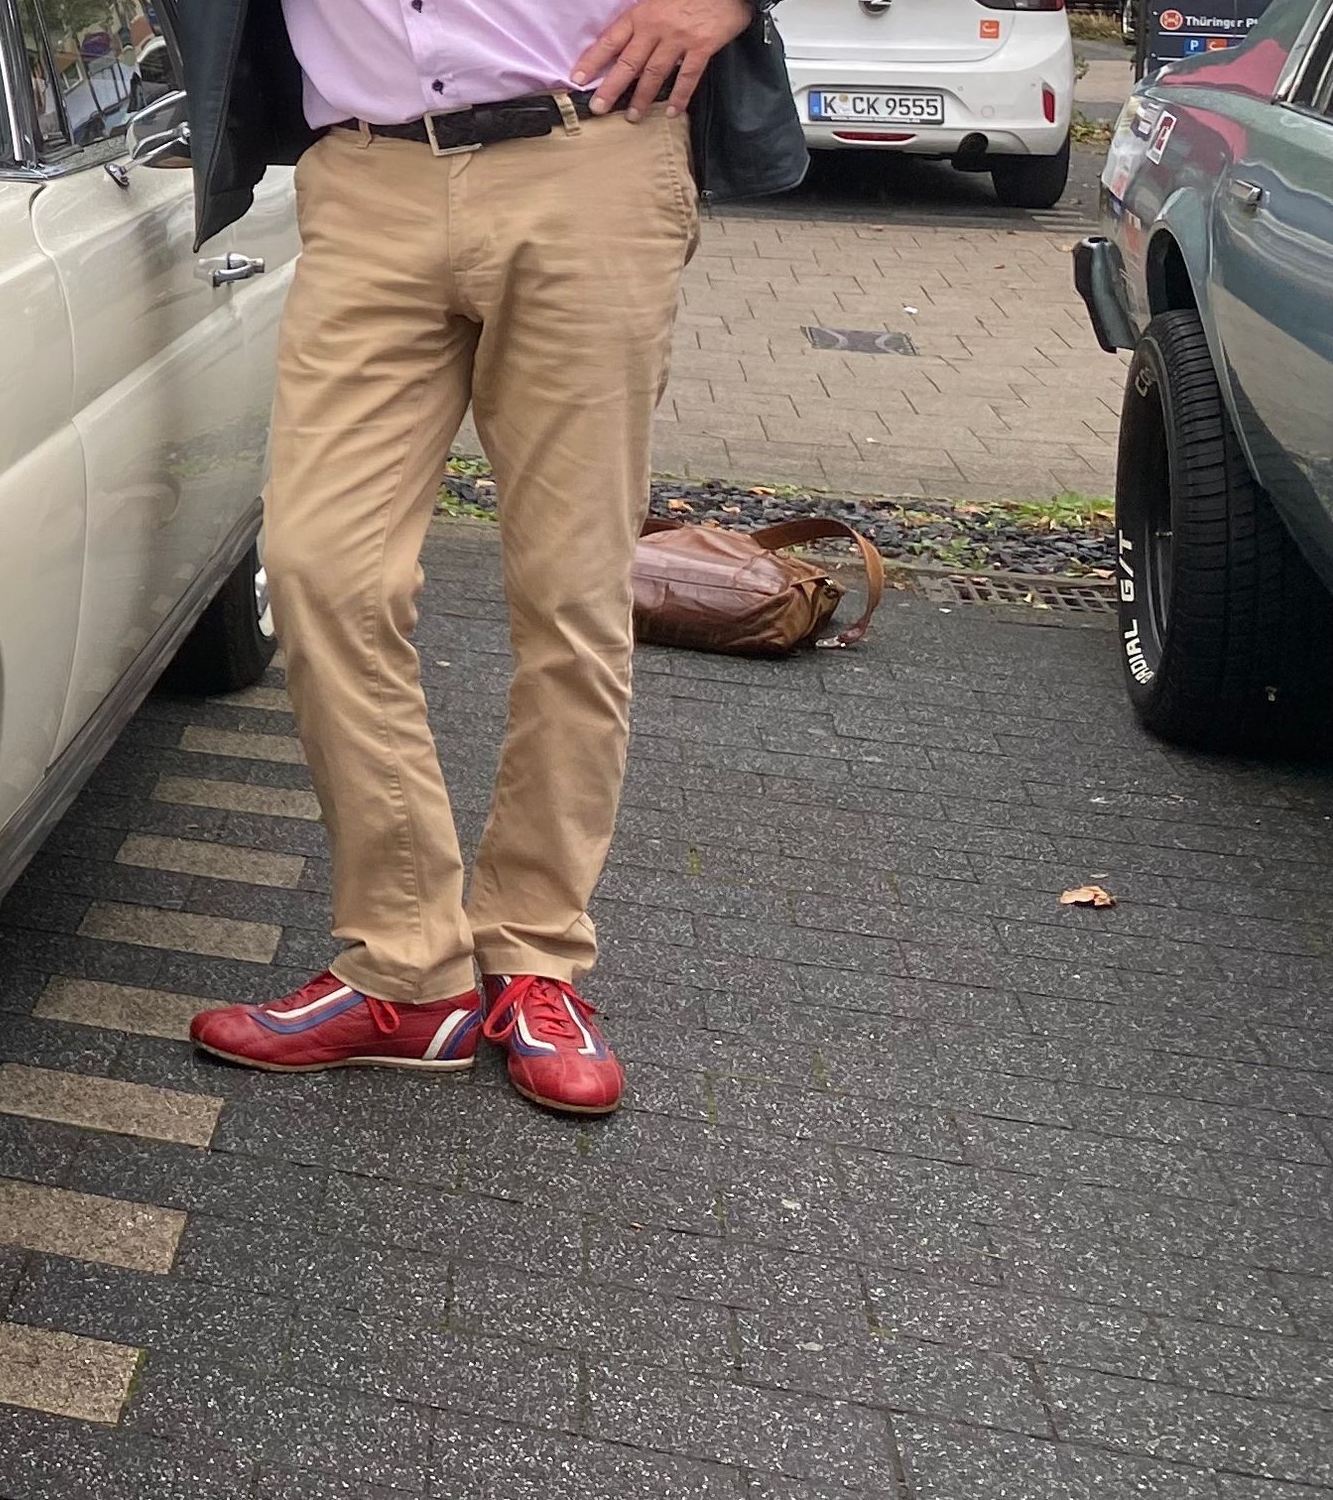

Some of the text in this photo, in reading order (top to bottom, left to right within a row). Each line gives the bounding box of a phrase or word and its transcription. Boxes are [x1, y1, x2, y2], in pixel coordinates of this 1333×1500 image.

[1185, 15, 1244, 29] Thüringer
[1190, 40, 1199, 51] P
[823, 95, 938, 117] K CK 9555
